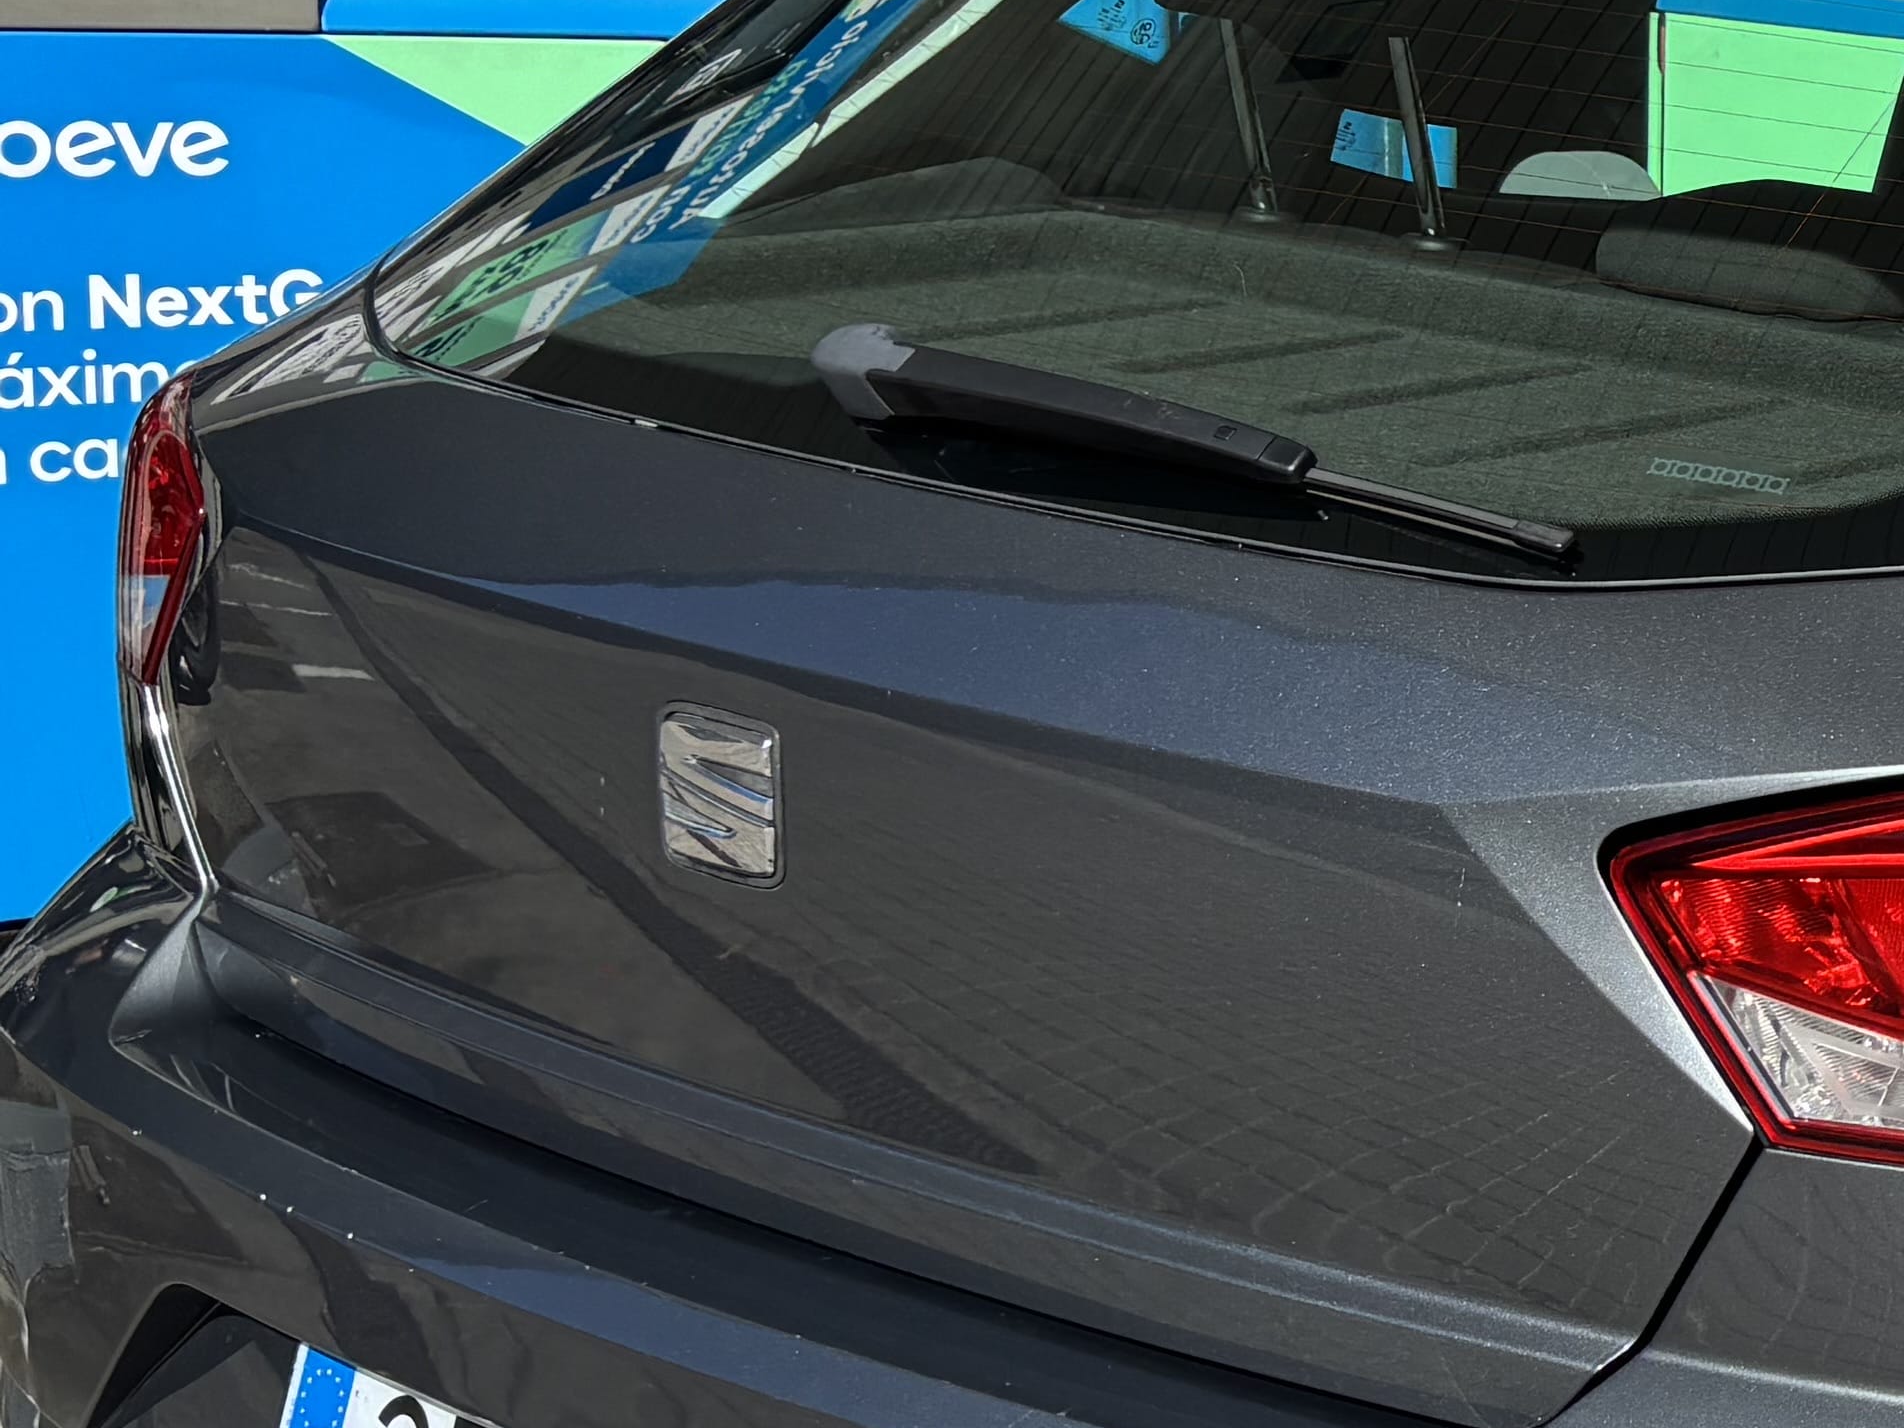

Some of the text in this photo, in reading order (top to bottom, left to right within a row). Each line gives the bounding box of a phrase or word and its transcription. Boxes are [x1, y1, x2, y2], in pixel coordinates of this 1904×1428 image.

[0, 117, 229, 177] oeve
[88, 268, 323, 329] NextG
[0, 348, 199, 410] áxim
[30, 437, 120, 483] ca
